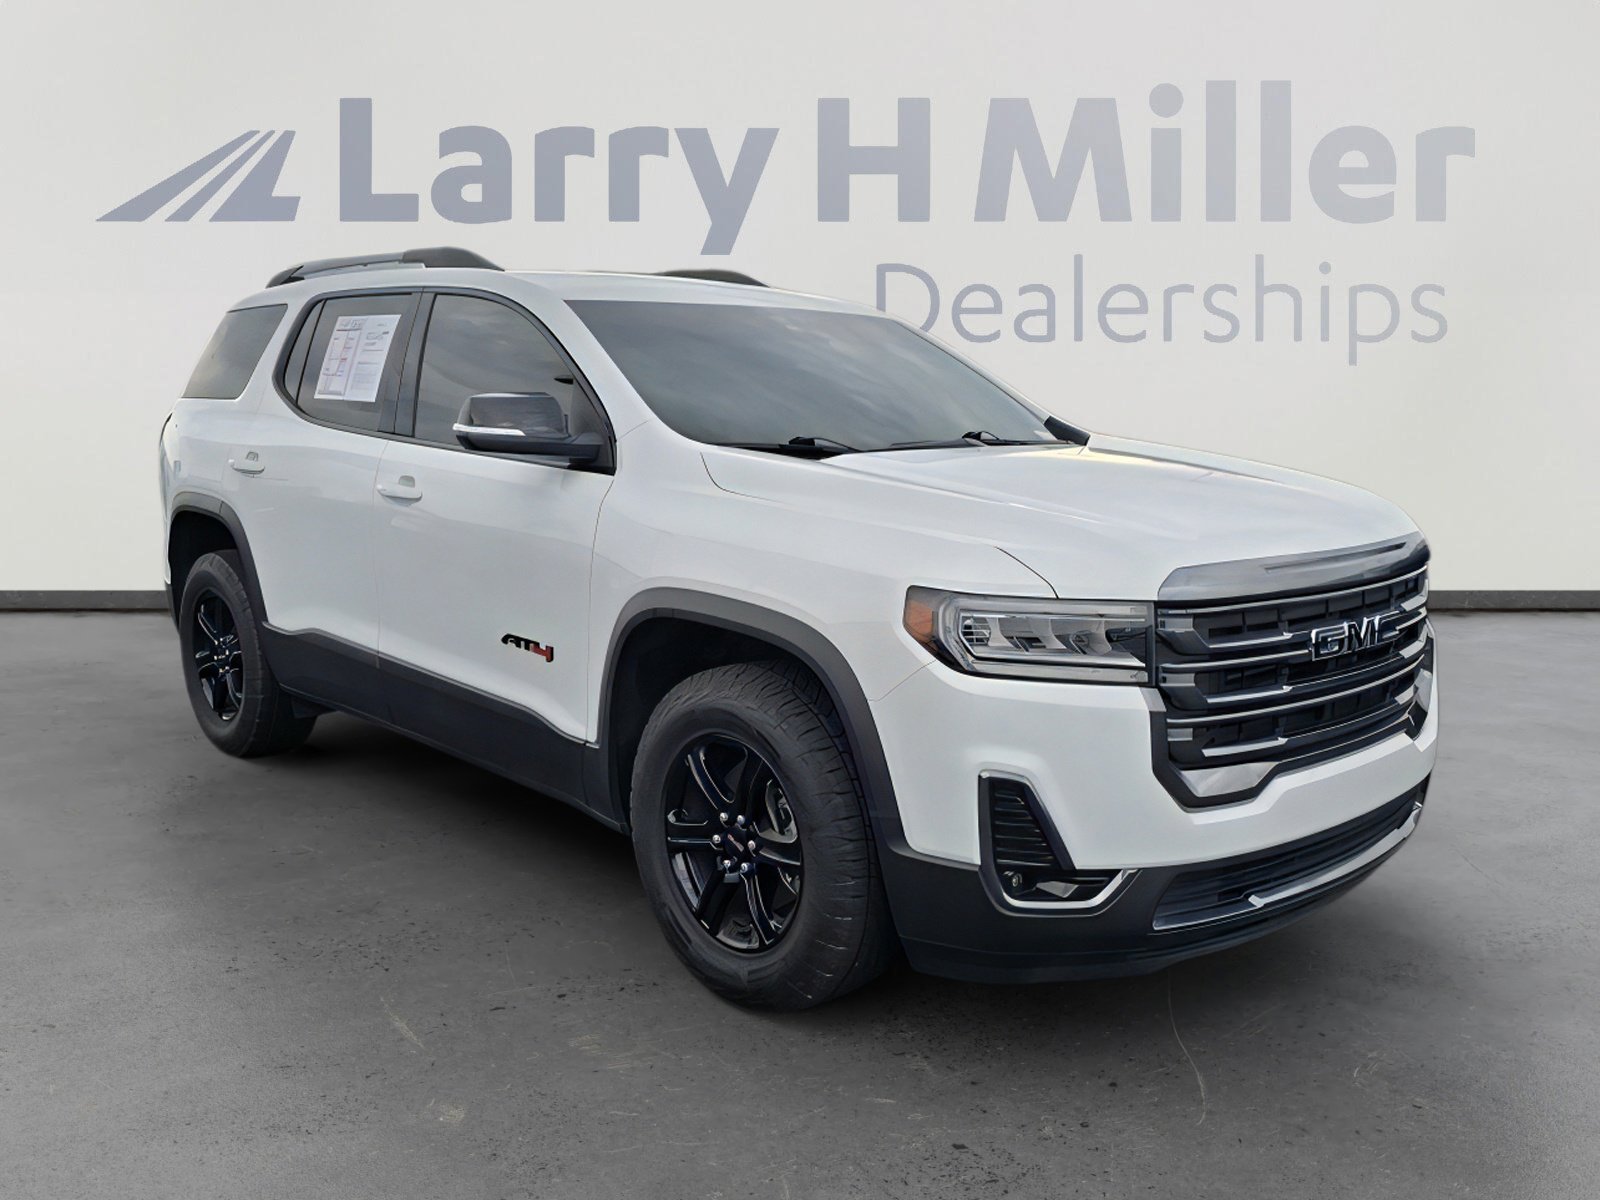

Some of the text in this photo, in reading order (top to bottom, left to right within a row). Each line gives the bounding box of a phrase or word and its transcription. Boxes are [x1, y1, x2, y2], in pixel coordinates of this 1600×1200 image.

[339, 80, 1476, 256] Larry H Miller
[876, 254, 1448, 366] Dealerships
[501, 633, 554, 662] AT4
[1311, 610, 1401, 661] GMC
